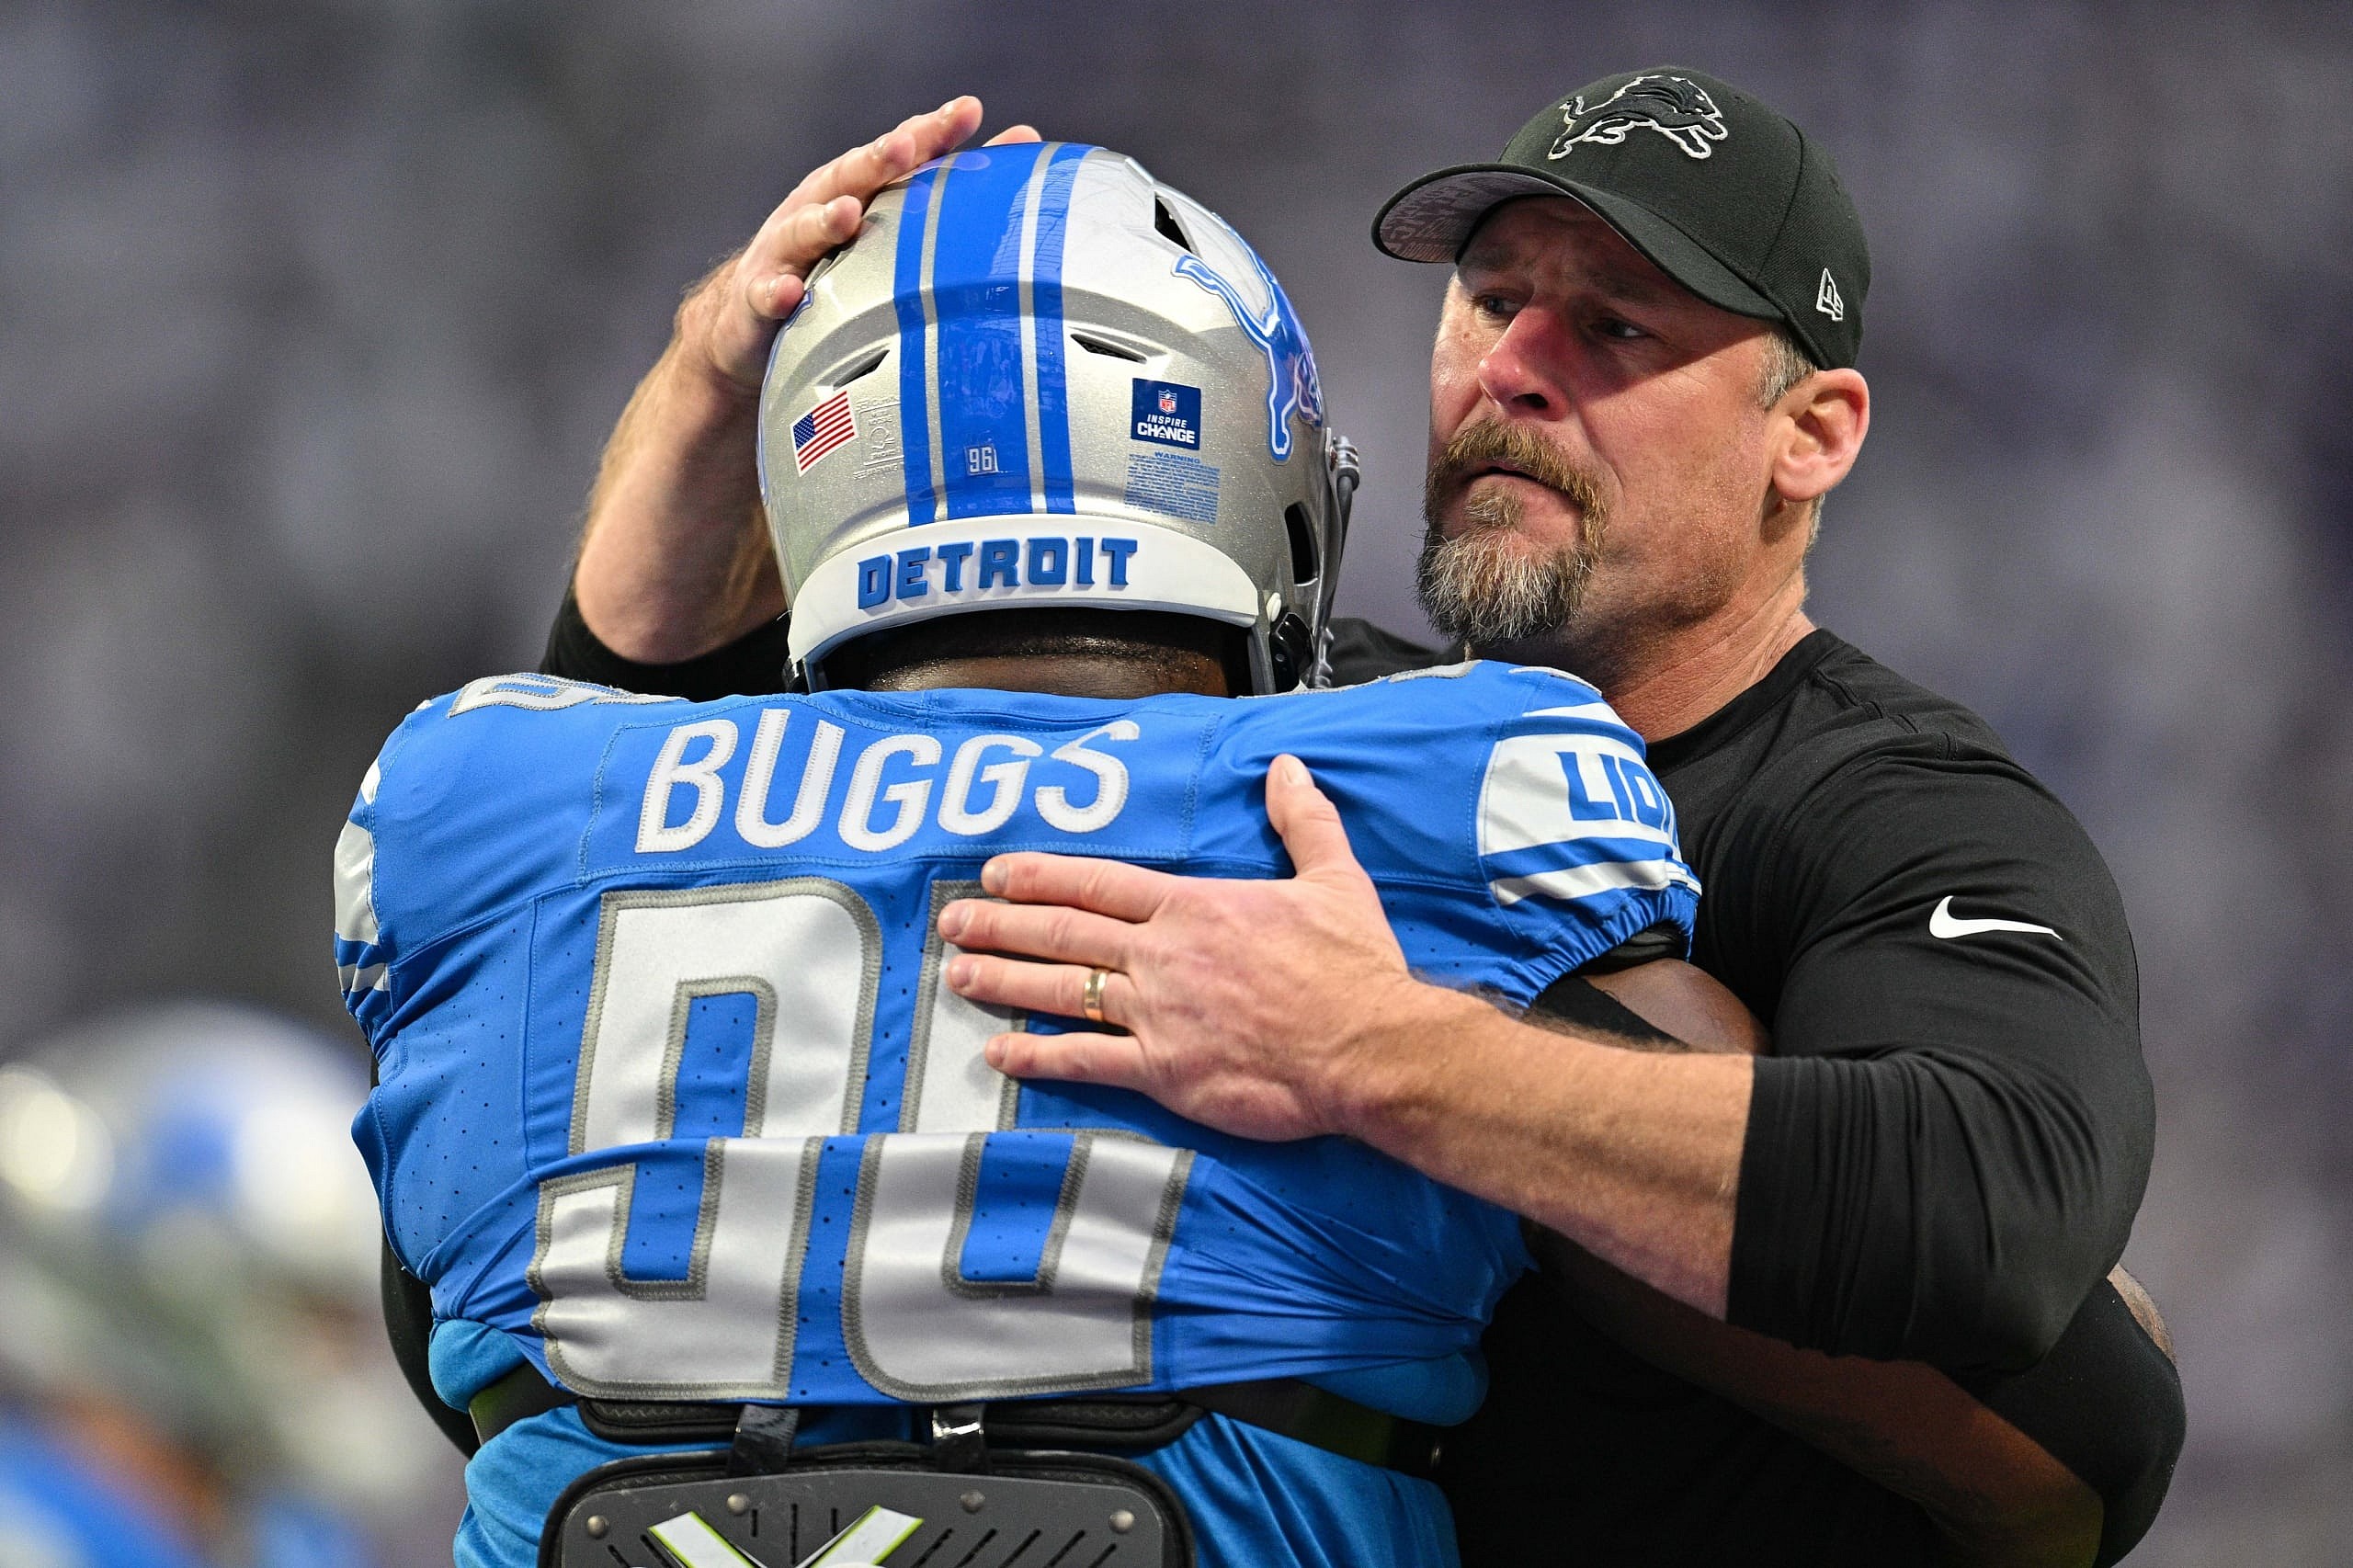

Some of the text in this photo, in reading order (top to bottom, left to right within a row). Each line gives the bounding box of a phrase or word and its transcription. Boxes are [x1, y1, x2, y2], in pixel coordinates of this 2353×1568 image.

[1136, 422, 1196, 445] CHANGE
[1146, 414, 1188, 429] INSPIRE
[968, 446, 994, 473] 96
[1154, 450, 1201, 464] WARNING
[857, 536, 1138, 610] DETROIT
[634, 708, 1141, 854] BUGGS
